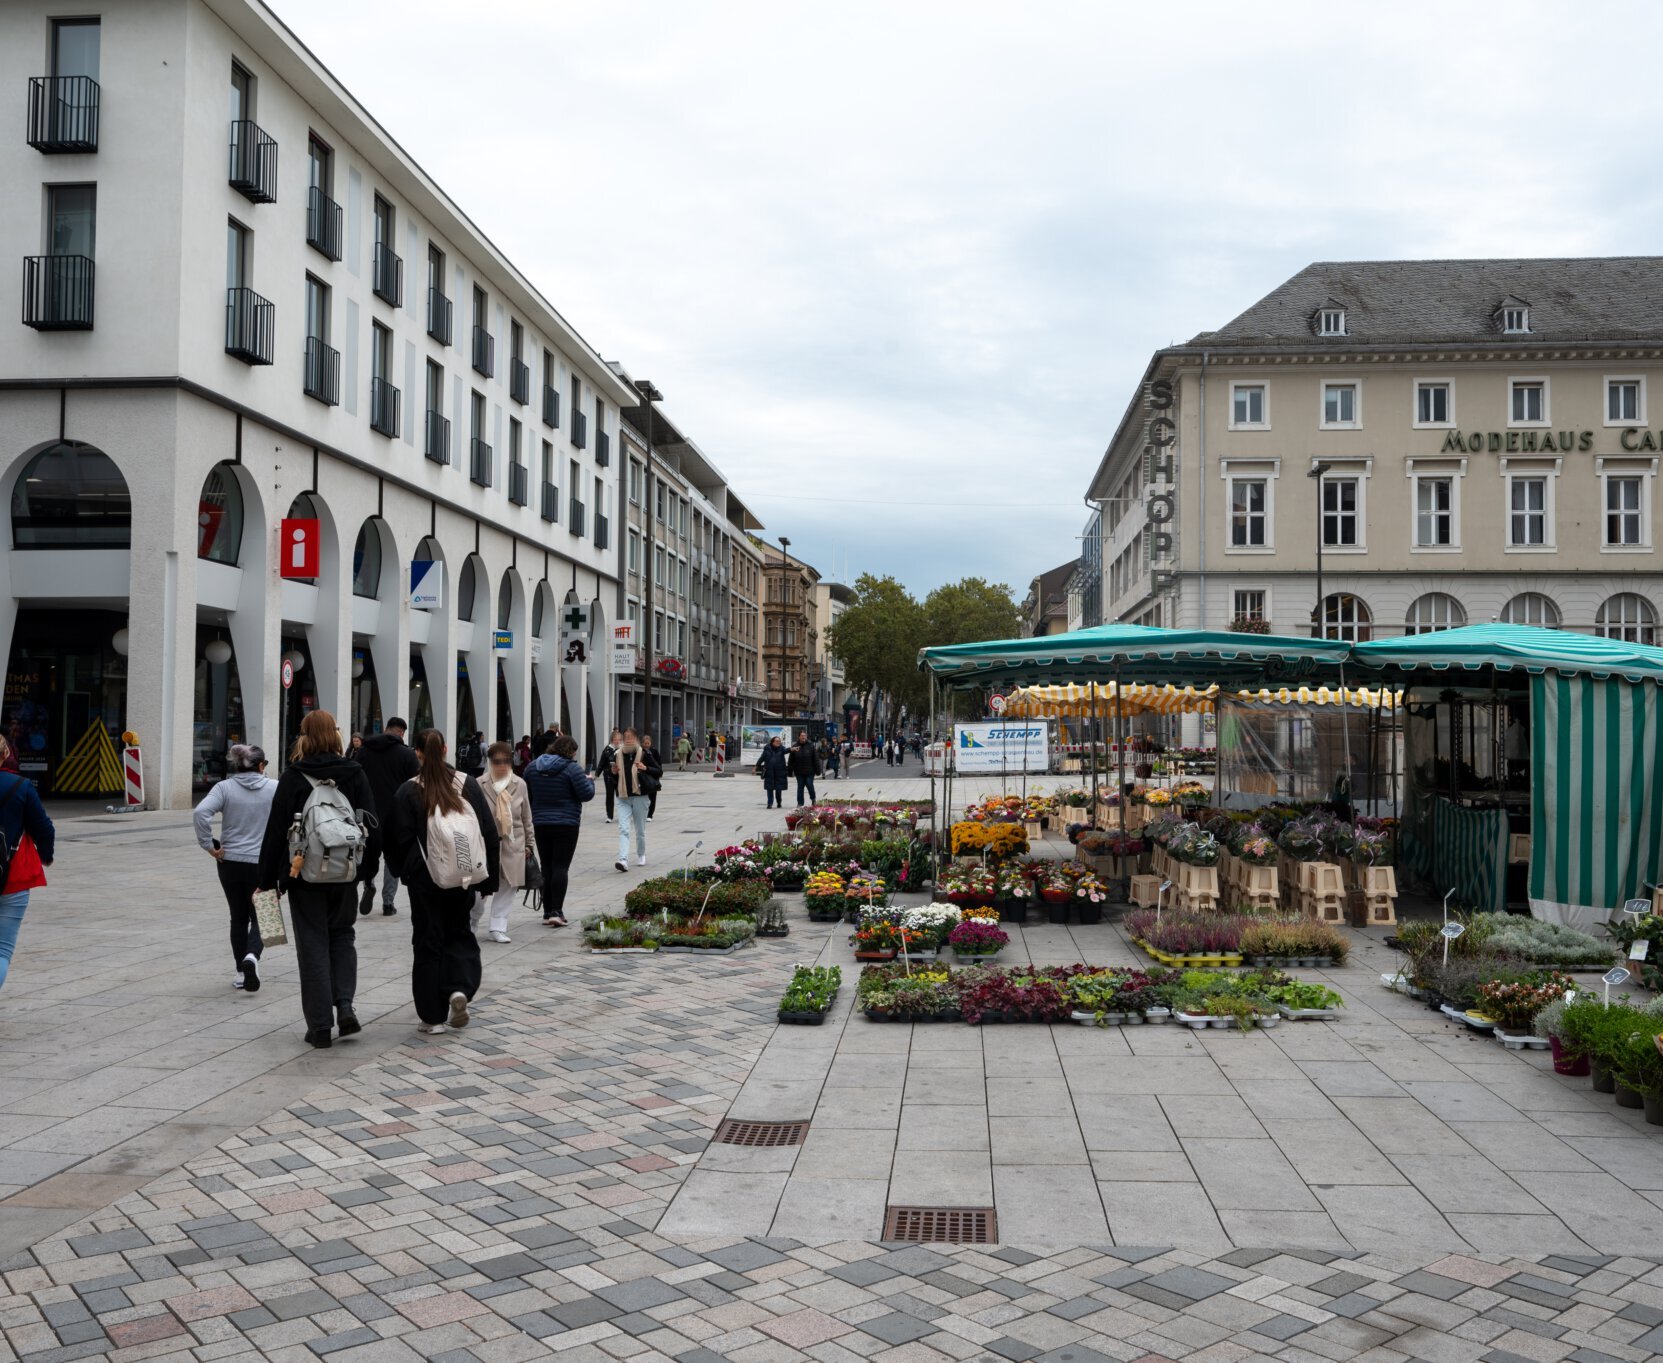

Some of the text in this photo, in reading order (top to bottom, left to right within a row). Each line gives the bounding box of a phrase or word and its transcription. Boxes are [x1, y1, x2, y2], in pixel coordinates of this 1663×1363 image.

[1441, 428, 1663, 452] MODEHAUS CA
[7, 672, 40, 684] TMAS
[5, 684, 30, 695] DEN
[987, 728, 1042, 739] SCHEMPP
[453, 831, 473, 873] NIKE
